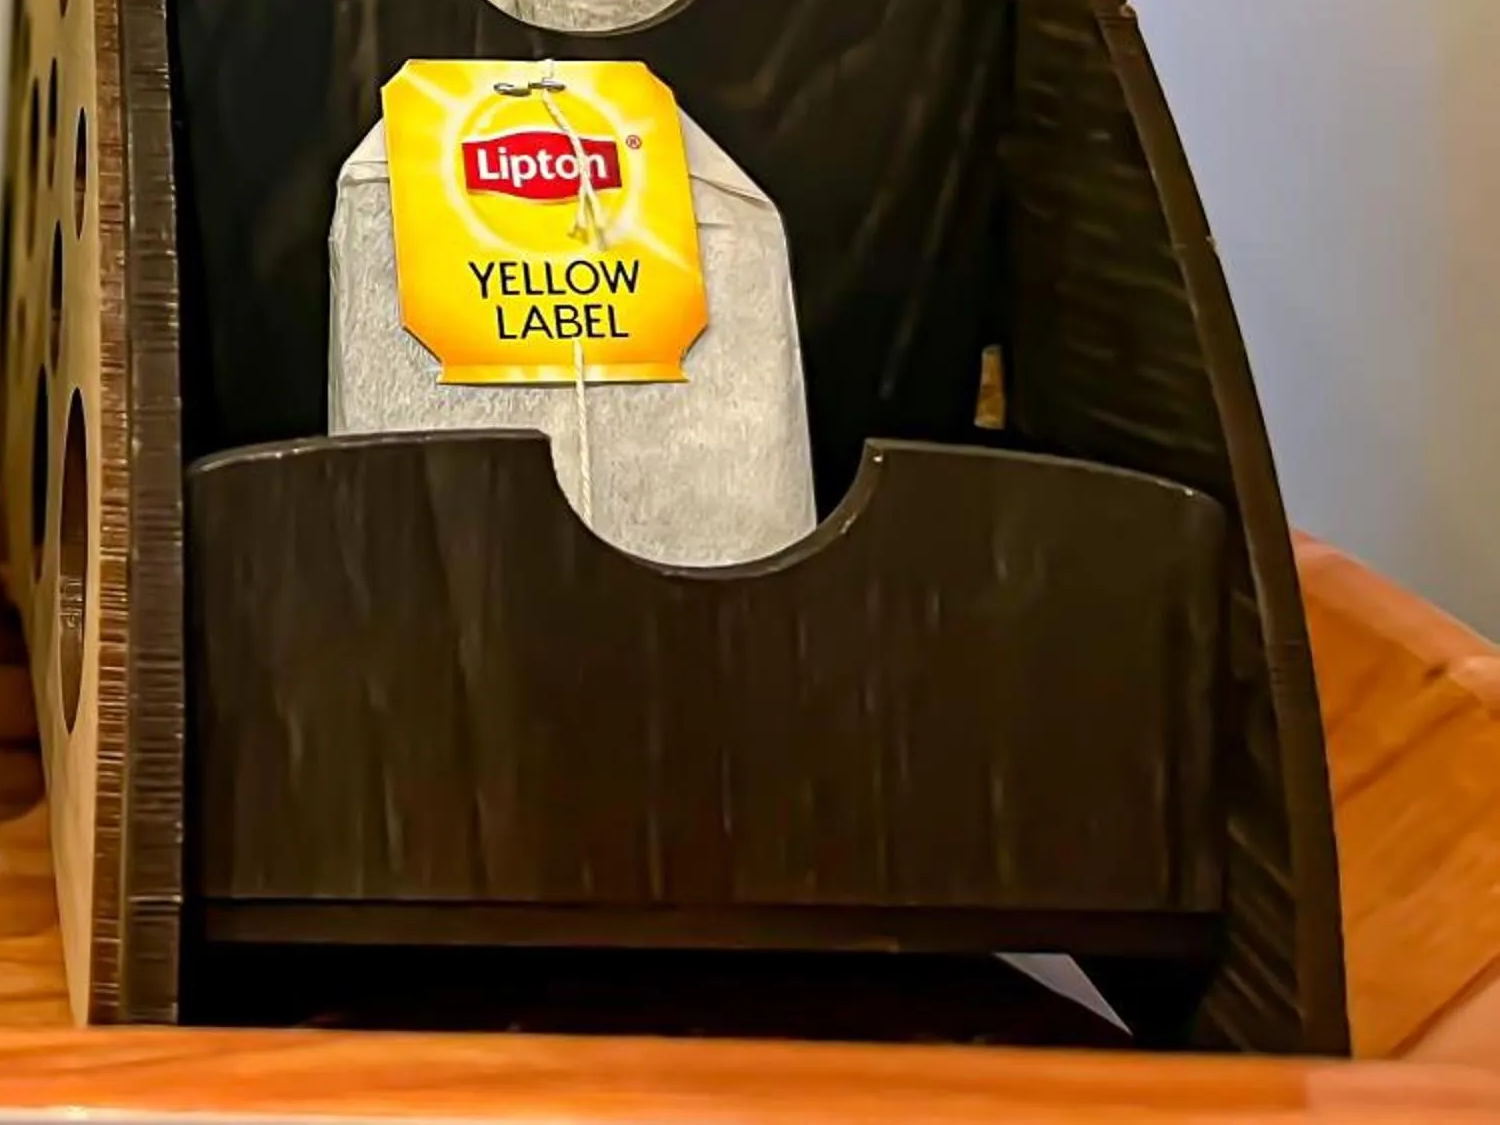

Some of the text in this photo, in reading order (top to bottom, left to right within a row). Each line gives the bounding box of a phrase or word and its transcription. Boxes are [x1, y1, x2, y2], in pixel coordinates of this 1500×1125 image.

[476, 146, 608, 189] Lipton
[468, 259, 641, 300] YELLOW
[496, 304, 630, 340] LABEL
